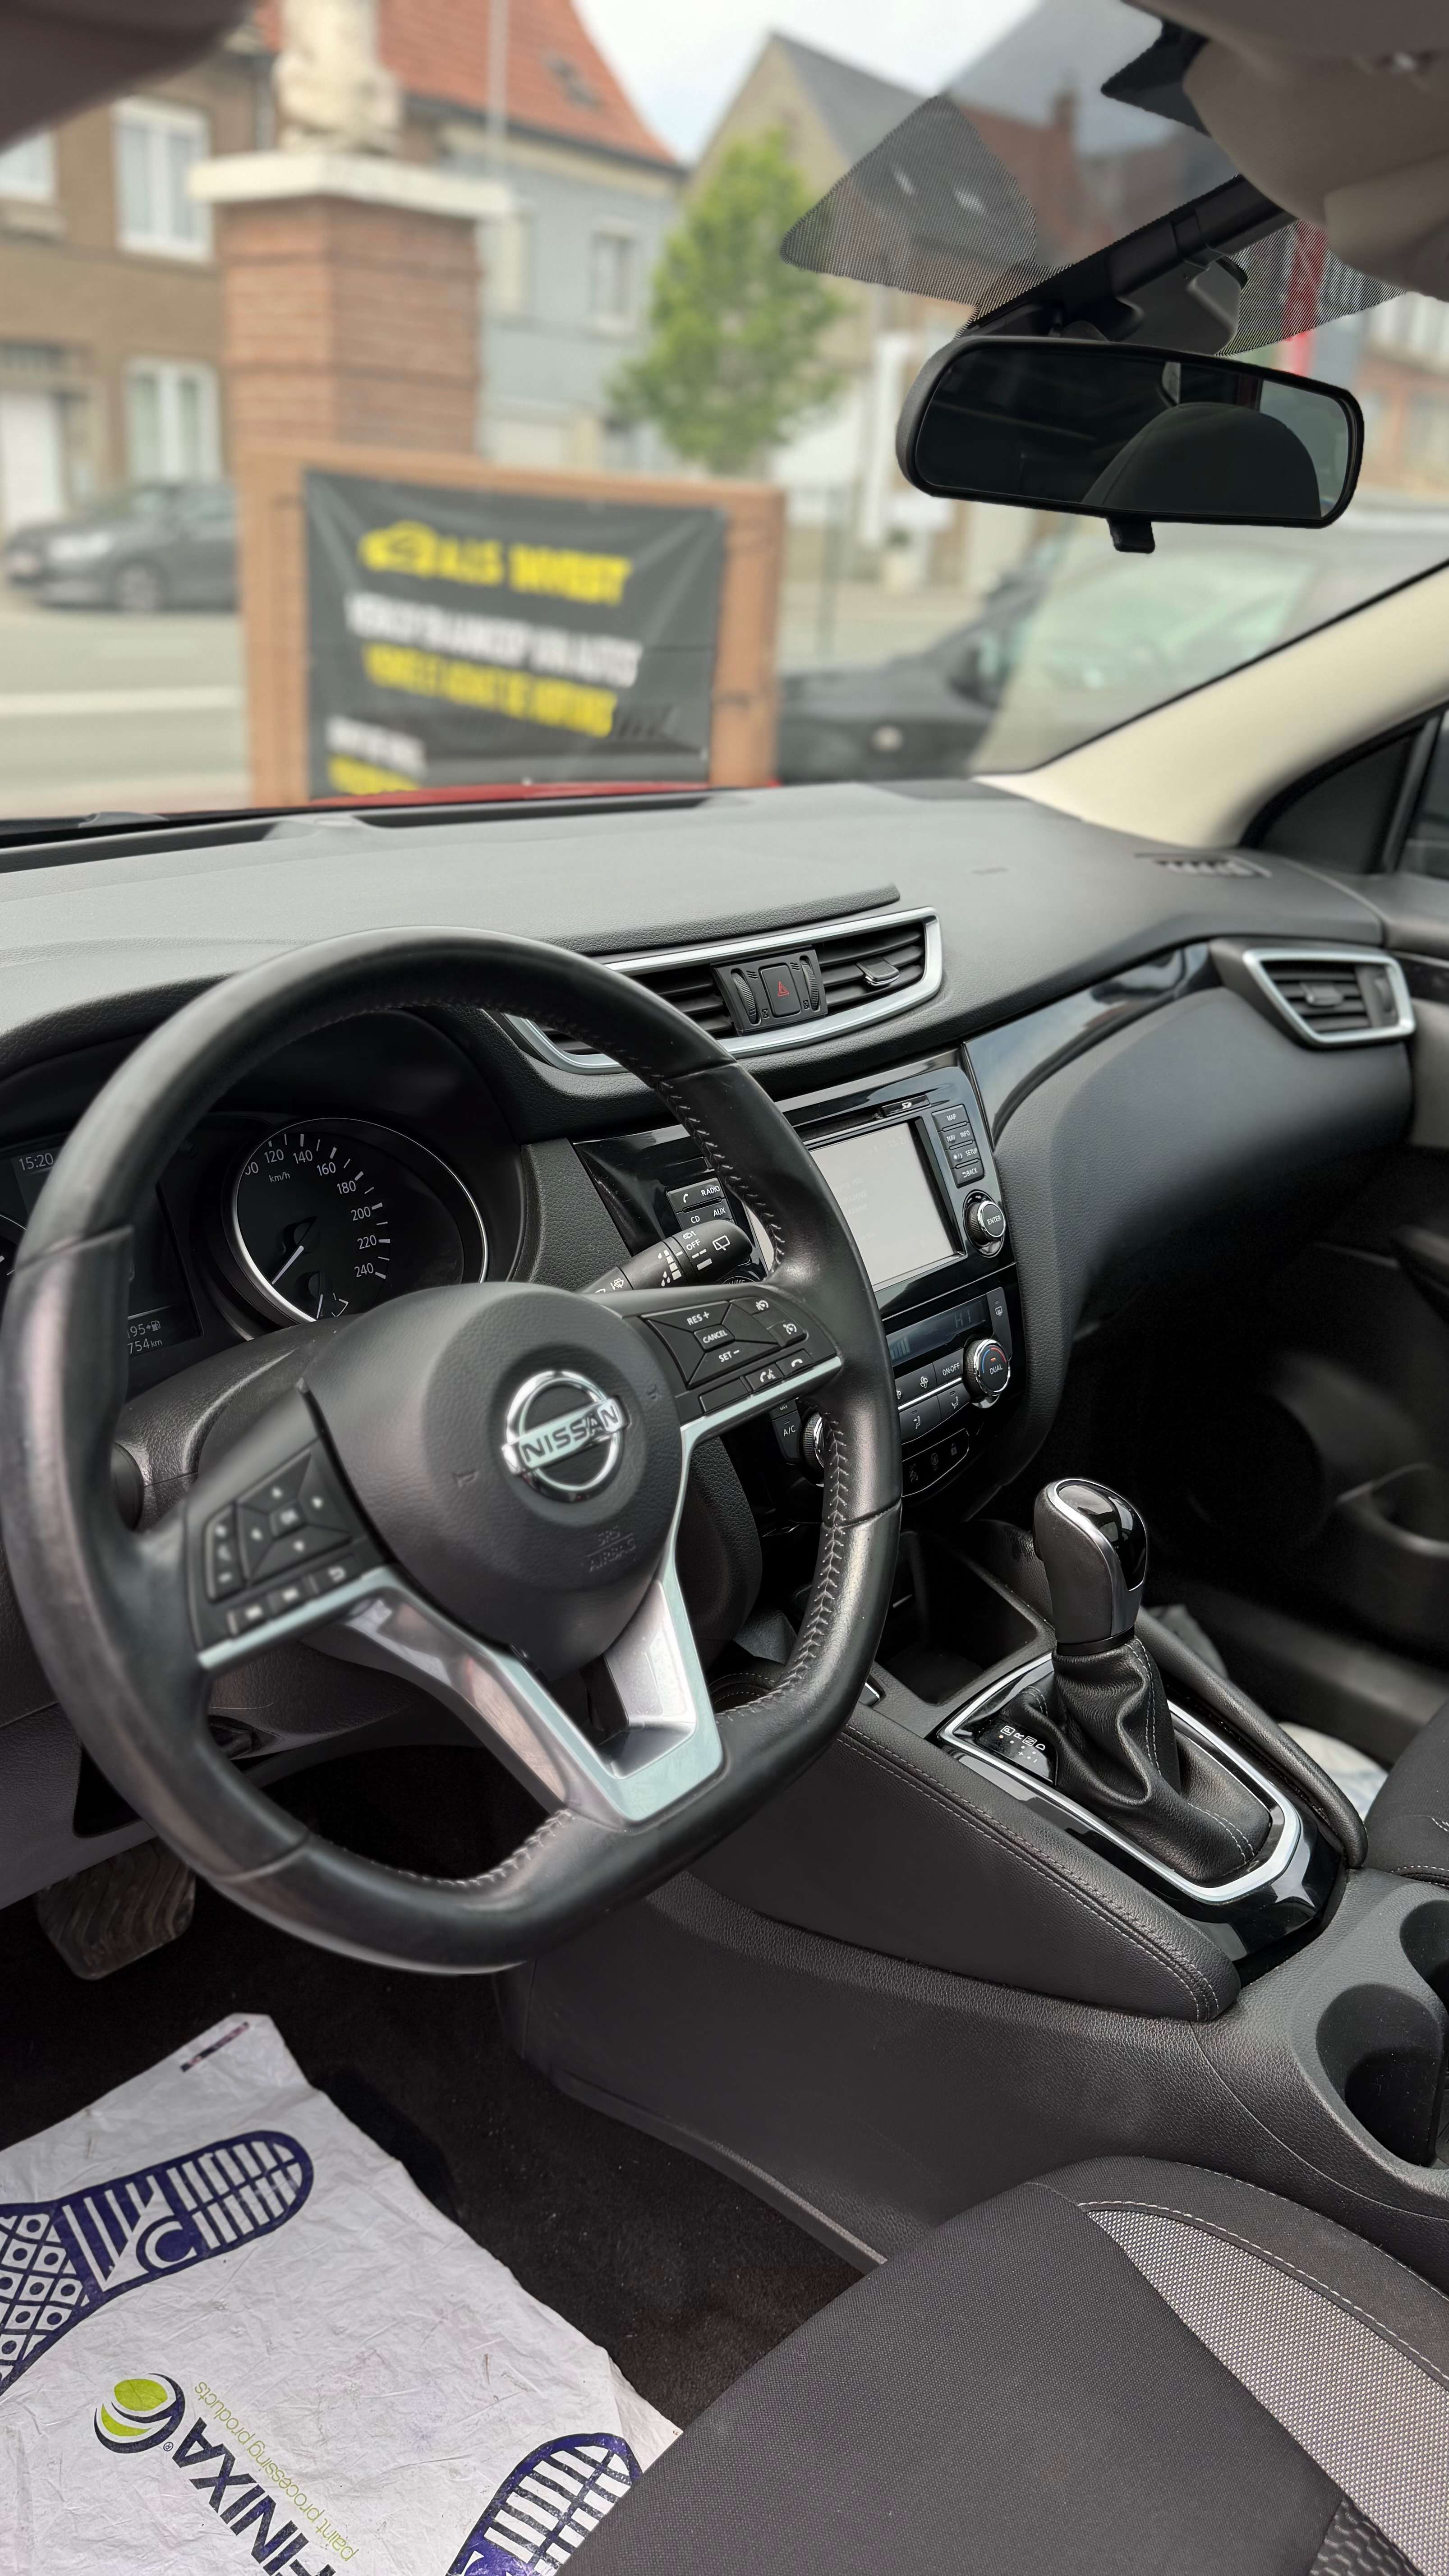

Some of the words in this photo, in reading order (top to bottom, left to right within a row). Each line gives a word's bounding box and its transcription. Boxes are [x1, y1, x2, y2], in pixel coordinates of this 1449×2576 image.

[960, 1130, 970, 1138] INFO
[19, 1152, 54, 1171] 15:20
[264, 1149, 284, 1164] 120
[293, 1150, 313, 1164] 140
[317, 1162, 336, 1176] 160
[966, 1167, 978, 1177] BACK
[268, 1171, 290, 1182] km/h
[336, 1180, 356, 1195] 180
[700, 1185, 721, 1196] RADIO
[350, 1206, 371, 1221] 200
[713, 1207, 726, 1217] AUX
[690, 1215, 700, 1224] CD
[987, 1215, 1001, 1225] ENTER
[357, 1235, 377, 1249] 220
[686, 1239, 700, 1251] OFF
[354, 1263, 374, 1278] 240
[703, 1329, 728, 1344] CANCEL
[989, 1364, 1003, 1375] DUAL
[521, 1404, 619, 1463] NISSAN
[783, 1425, 796, 1436] A/C
[194, 2381, 256, 2446] products
[247, 2439, 326, 2523] processing
[316, 2518, 359, 2562] paint
